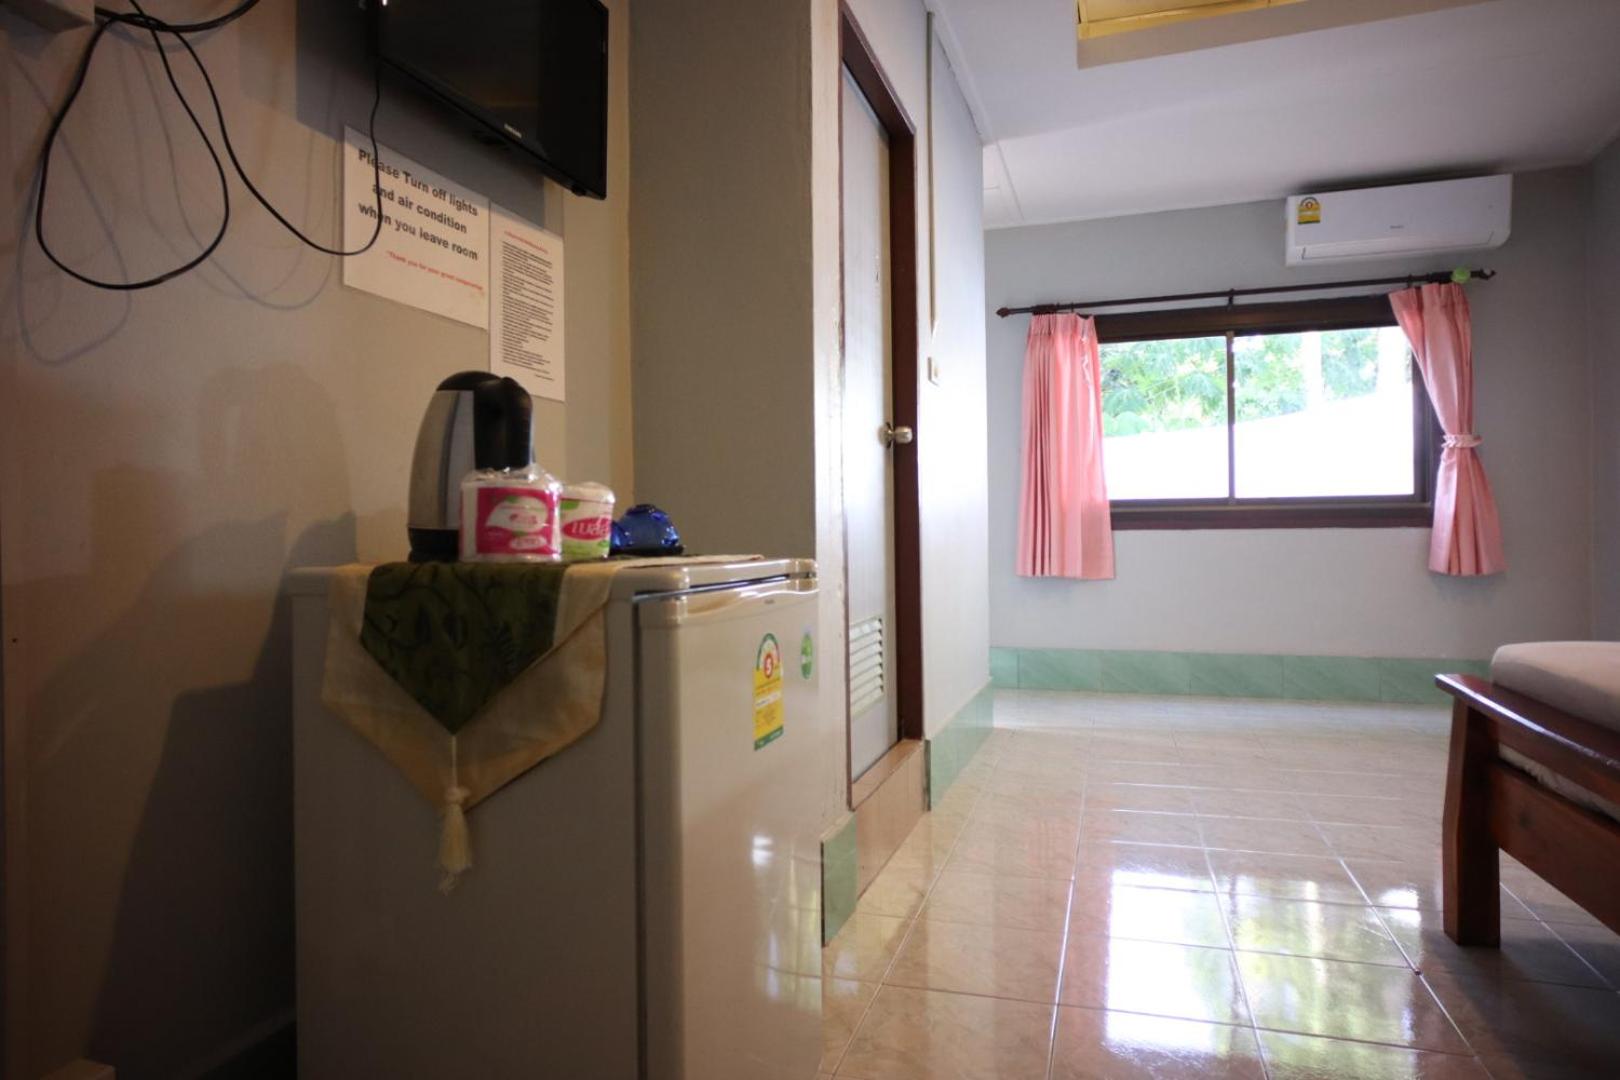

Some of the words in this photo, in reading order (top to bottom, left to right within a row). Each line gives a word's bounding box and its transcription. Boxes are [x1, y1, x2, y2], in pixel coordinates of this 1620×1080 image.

[397, 196, 414, 210] air
[416, 204, 467, 233] condition
[402, 171, 429, 193] Turn
[432, 188, 447, 202] off
[449, 193, 478, 217] lights
[358, 203, 391, 225] whn
[395, 219, 416, 236] you
[420, 227, 449, 248] leave
[451, 242, 478, 260] room
